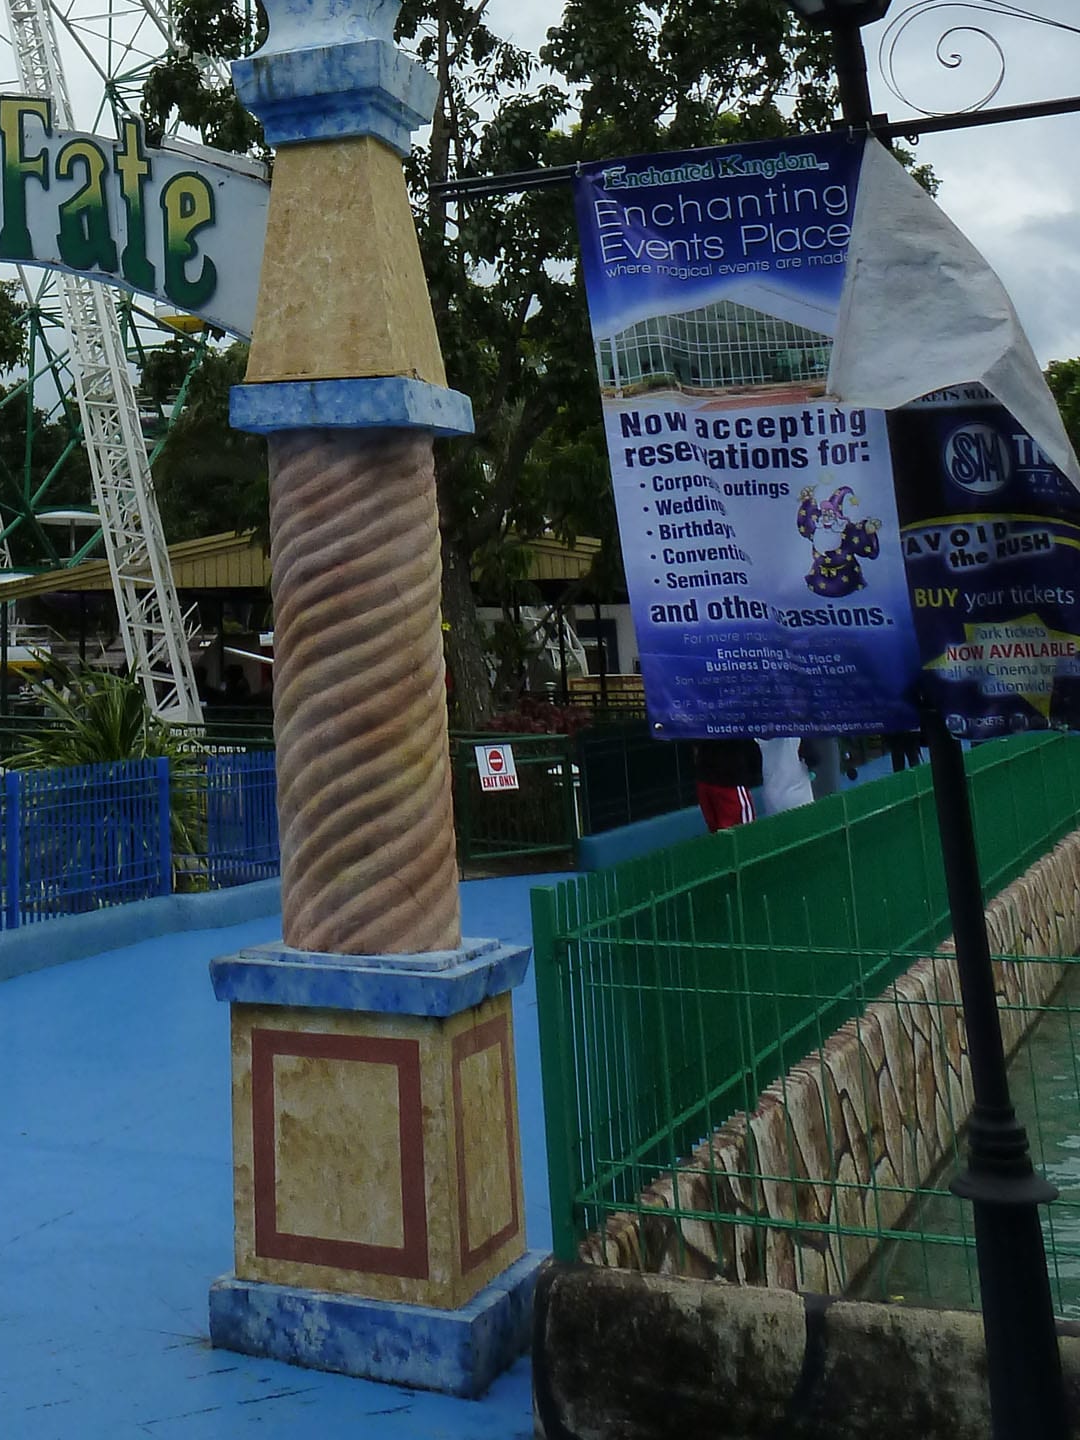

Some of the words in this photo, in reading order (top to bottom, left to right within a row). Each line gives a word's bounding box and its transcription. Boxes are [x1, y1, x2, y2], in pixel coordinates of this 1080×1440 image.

[602, 164, 713, 191] Enchanted
[718, 151, 819, 180] Kingdom
[594, 183, 849, 229] Enchanting
[599, 232, 724, 264] Events
[740, 222, 851, 256] Place
[605, 263, 651, 278] where
[656, 263, 713, 280] magical
[718, 260, 770, 275] events
[775, 257, 802, 269] are
[620, 411, 687, 438] Now
[694, 408, 867, 443] accepting
[624, 440, 809, 469] reservations
[817, 440, 870, 465] for:
[950, 431, 1005, 486] SM
[723, 480, 790, 498] outings
[906, 523, 1008, 555] AVOID
[949, 549, 989, 567] the
[997, 532, 1051, 558] RUSH
[666, 570, 748, 589] Seminars
[651, 598, 697, 623] and
[708, 596, 768, 622] other
[914, 587, 959, 608] BUY
[964, 589, 1004, 613] your
[1011, 585, 1076, 606] tickets
[706, 632, 740, 642] more
[1005, 625, 1047, 640] tickets
[716, 648, 784, 660] Enchanting
[808, 654, 841, 664] Place
[947, 646, 985, 661] NOW
[990, 642, 1075, 659] AVAILABLE
[705, 660, 759, 672] Business
[823, 664, 857, 675] Team
[986, 663, 1038, 676] Cinema
[482, 775, 498, 788] EXIT
[499, 775, 517, 788] ONLY
